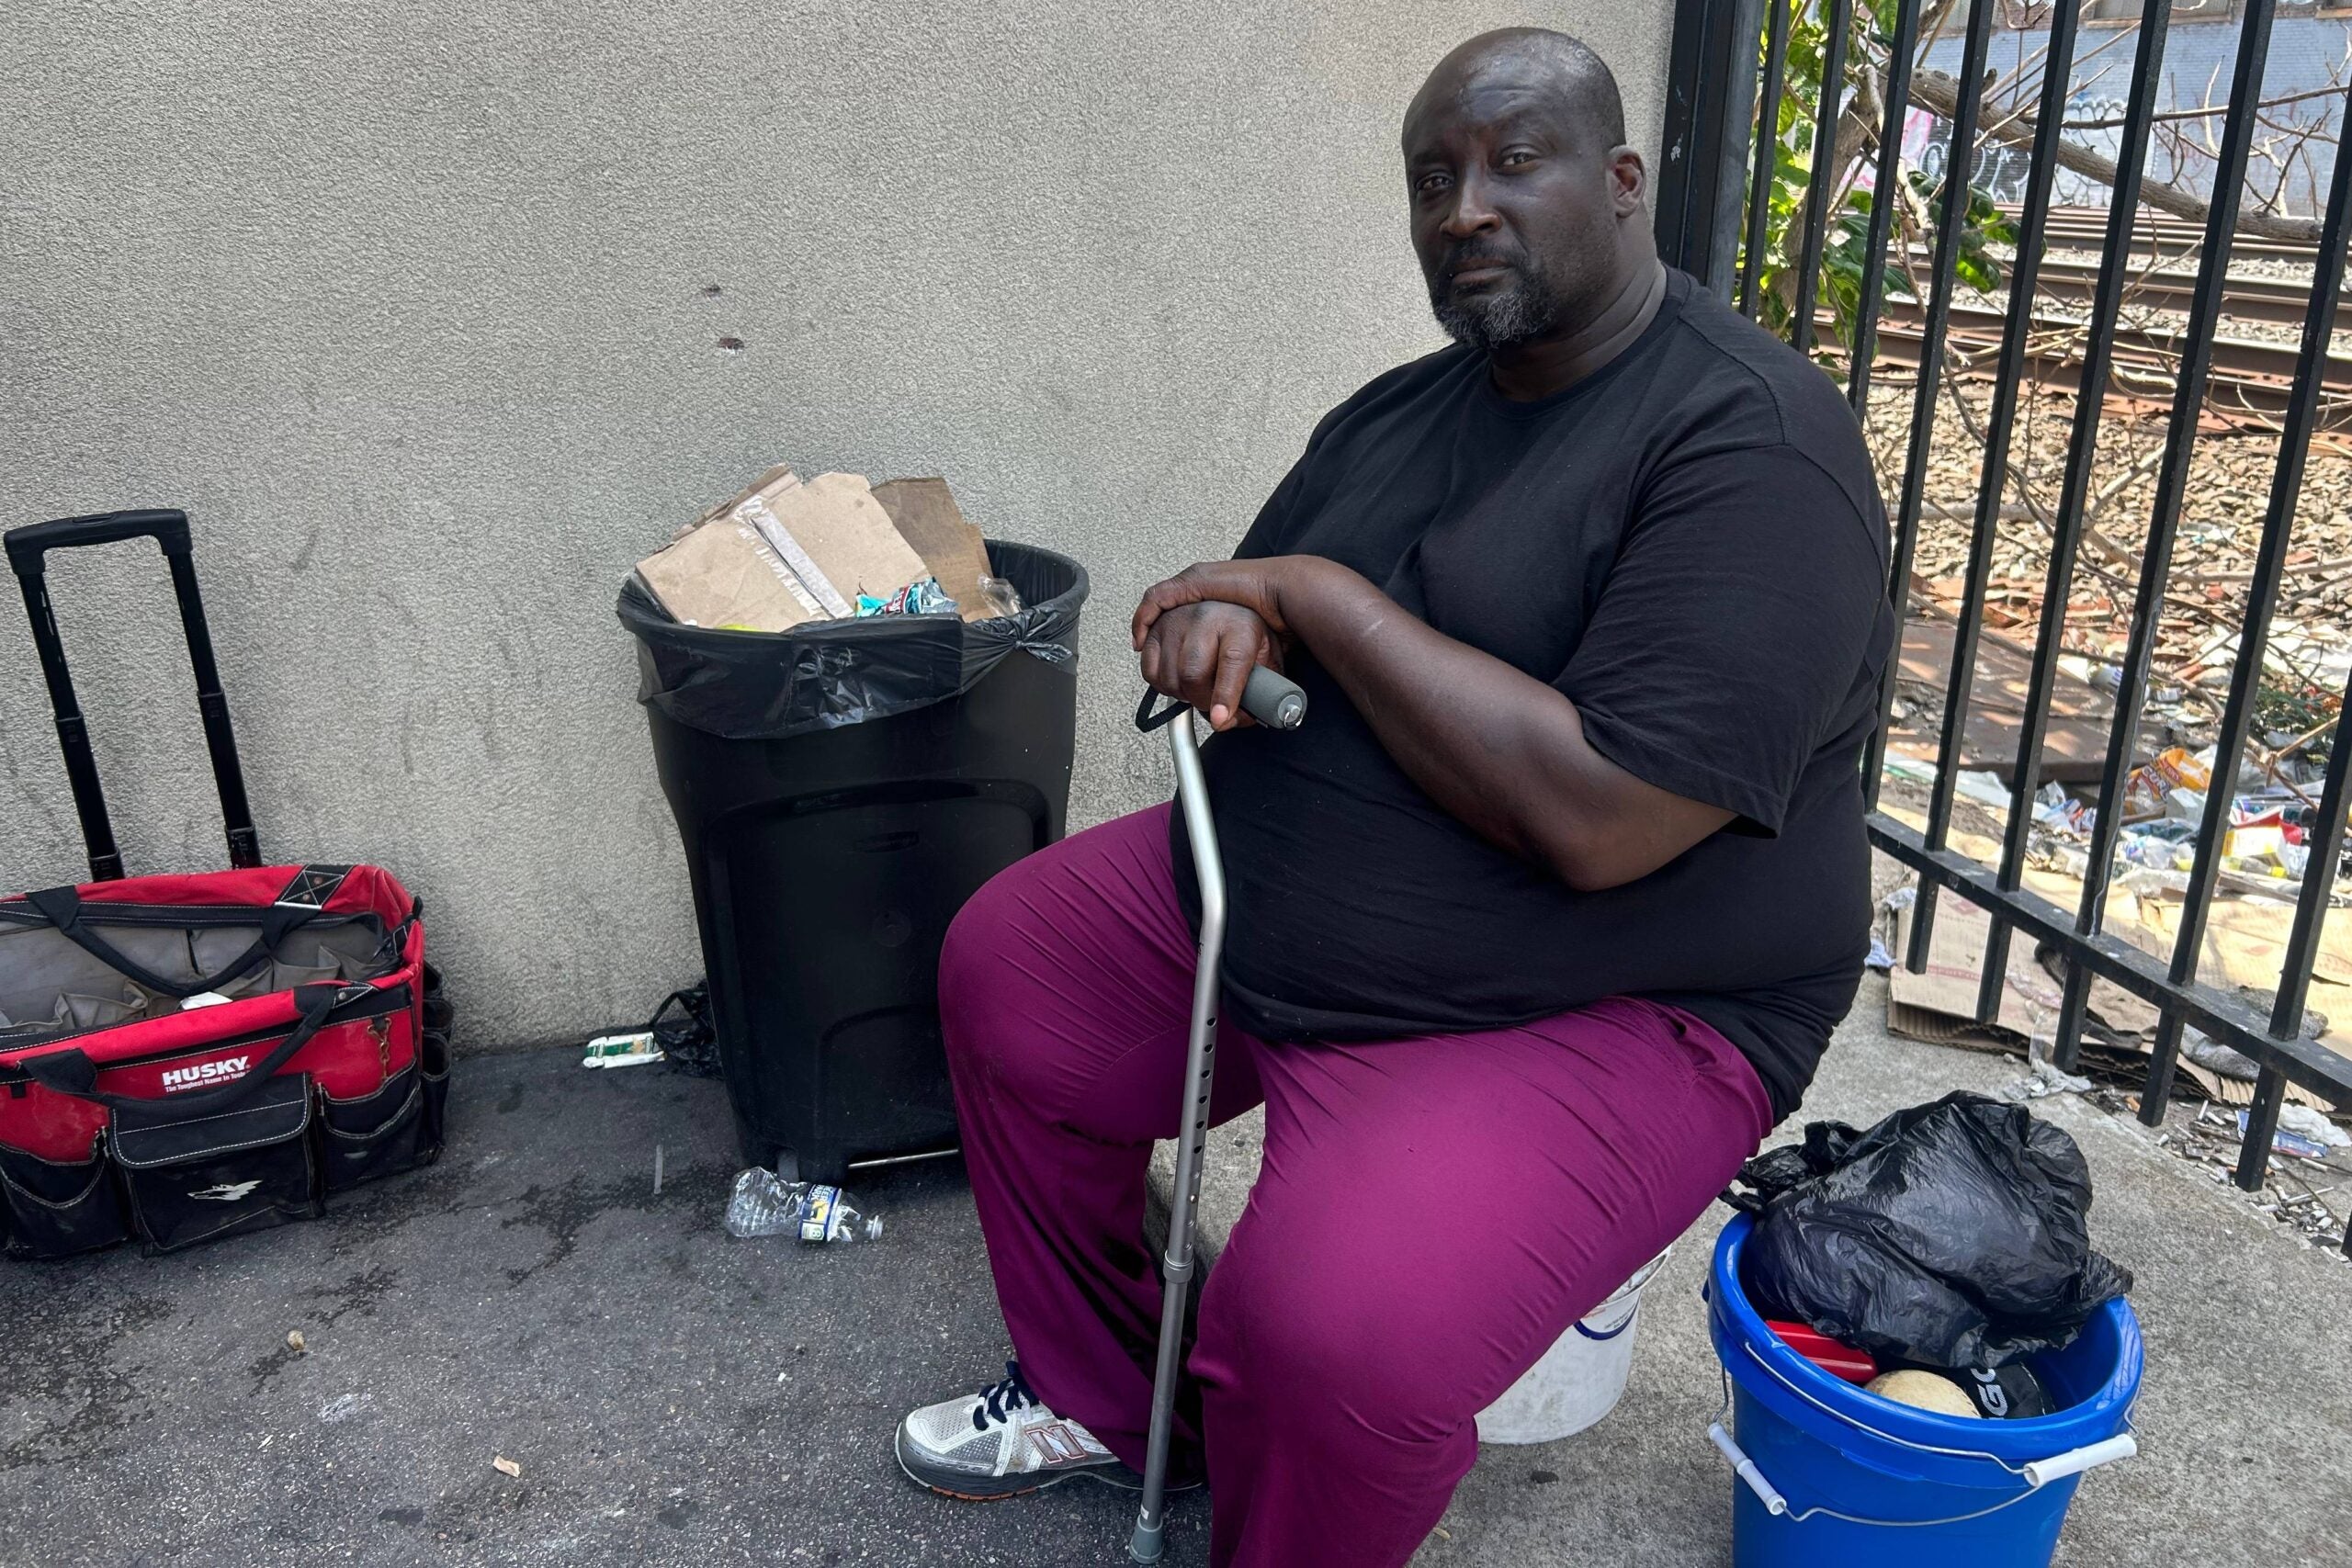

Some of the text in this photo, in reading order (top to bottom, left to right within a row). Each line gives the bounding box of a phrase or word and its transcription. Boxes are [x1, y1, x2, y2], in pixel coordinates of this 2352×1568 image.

[162, 1055, 248, 1086] HUSKY
[177, 1079, 203, 1089] Toughest
[204, 1077, 222, 1085] Name
[1024, 1424, 1088, 1464] N
